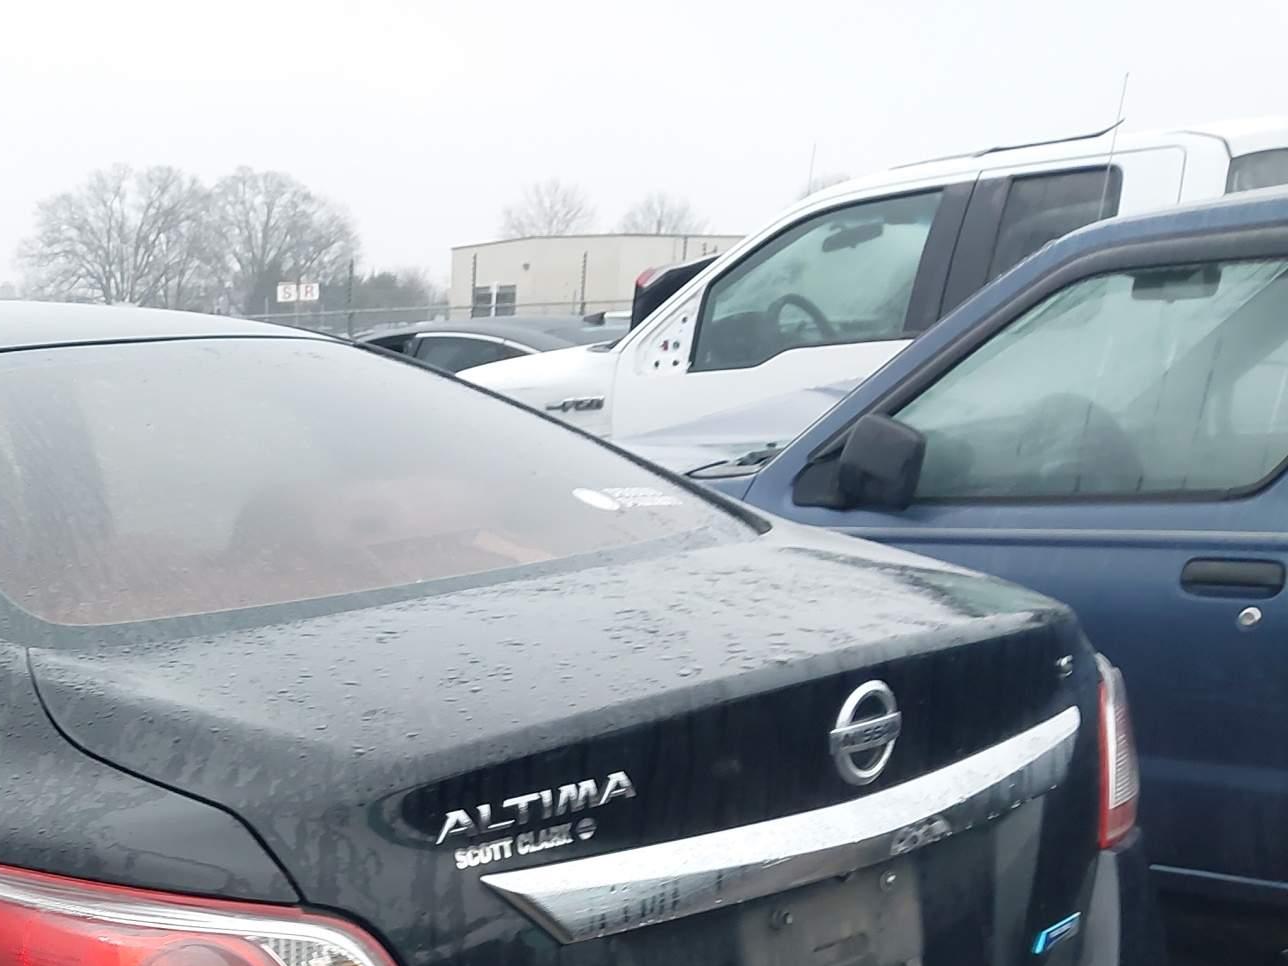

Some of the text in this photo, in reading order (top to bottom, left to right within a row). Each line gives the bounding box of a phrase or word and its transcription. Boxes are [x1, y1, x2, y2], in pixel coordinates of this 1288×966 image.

[435, 770, 637, 845] ALTIMA
[454, 821, 575, 870] SCOTT CLARK
